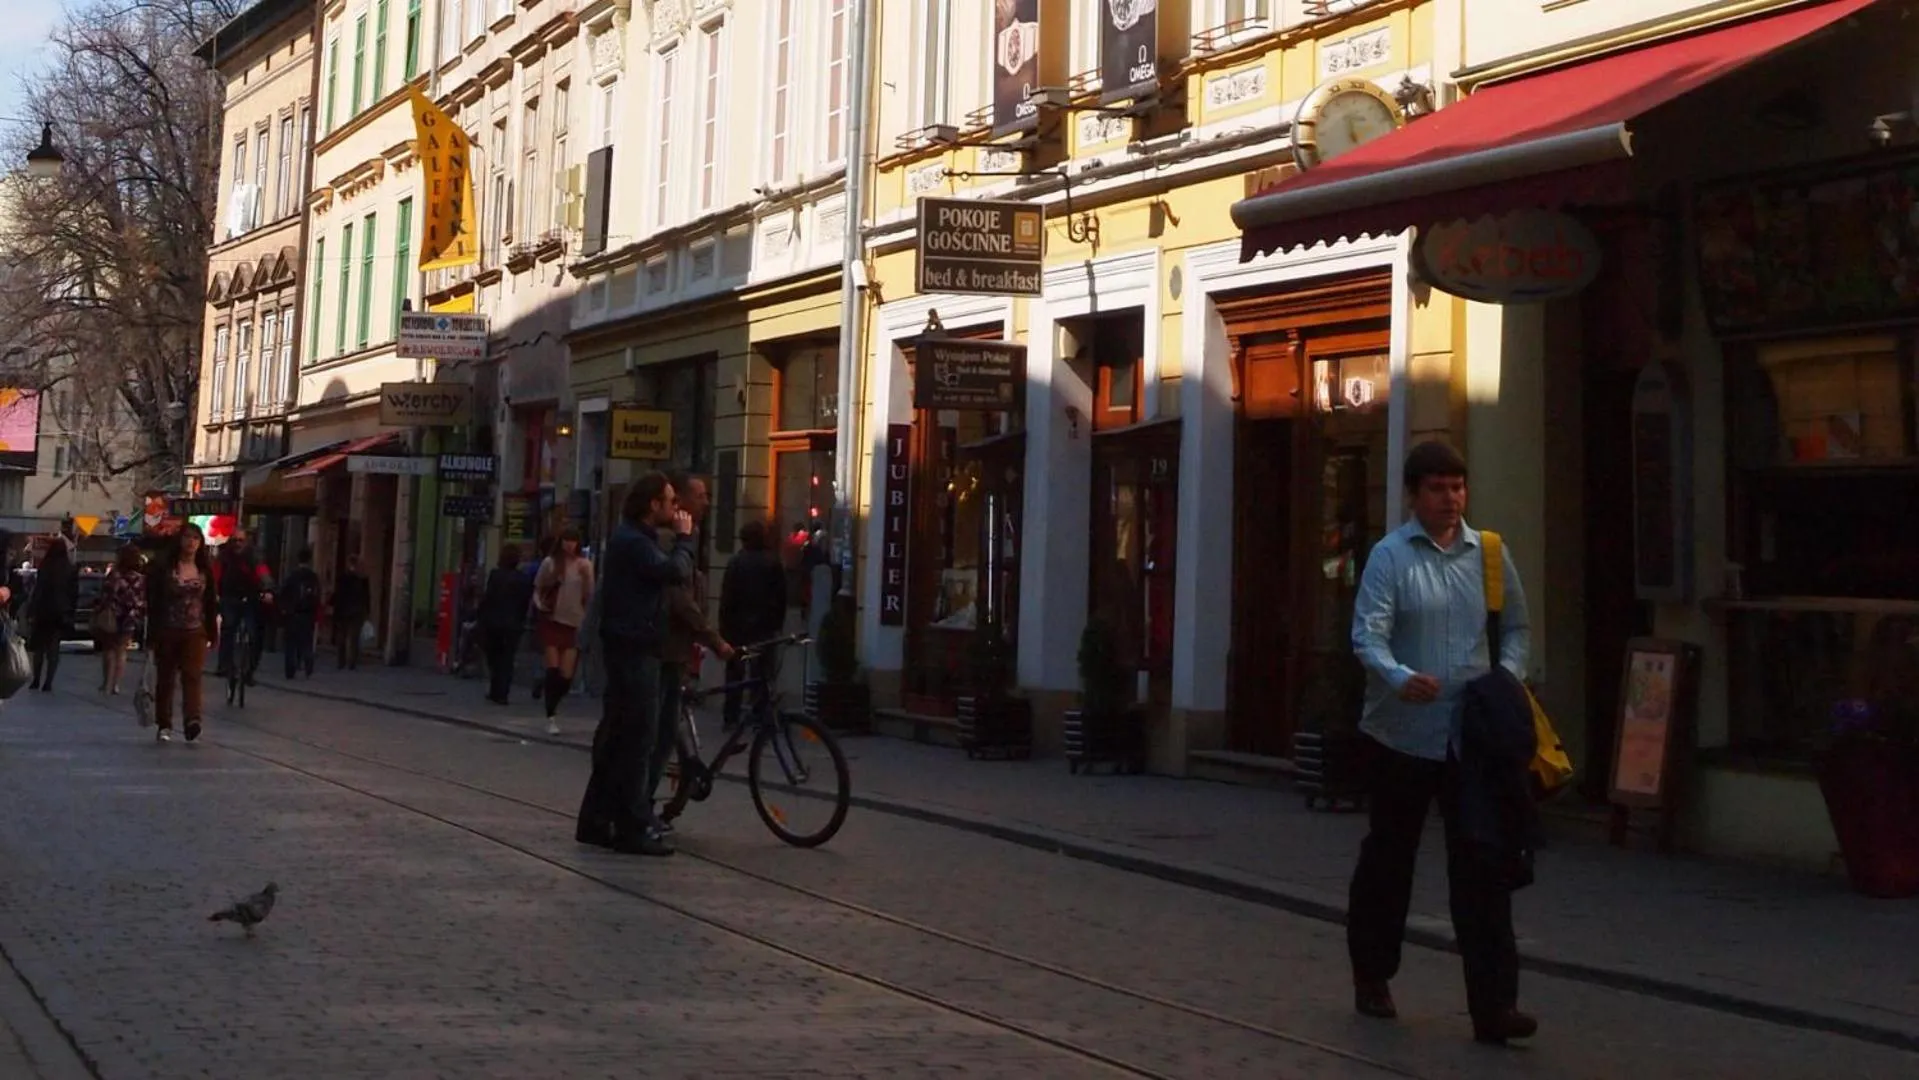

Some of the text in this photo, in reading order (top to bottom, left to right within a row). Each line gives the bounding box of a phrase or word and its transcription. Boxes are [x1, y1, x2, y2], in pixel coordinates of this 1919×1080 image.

[1130, 63, 1155, 82] OMEGA
[1015, 101, 1037, 118] OMEGA
[420, 111, 442, 261] GALERIA
[448, 132, 467, 257] ANTYKI
[939, 207, 1001, 233] POKOJE
[927, 227, 1012, 254] GOŚCINNE
[924, 266, 1039, 293] bed & breakfast
[440, 454, 493, 471] ALKOHOLE
[886, 438, 907, 611] JUBILER
